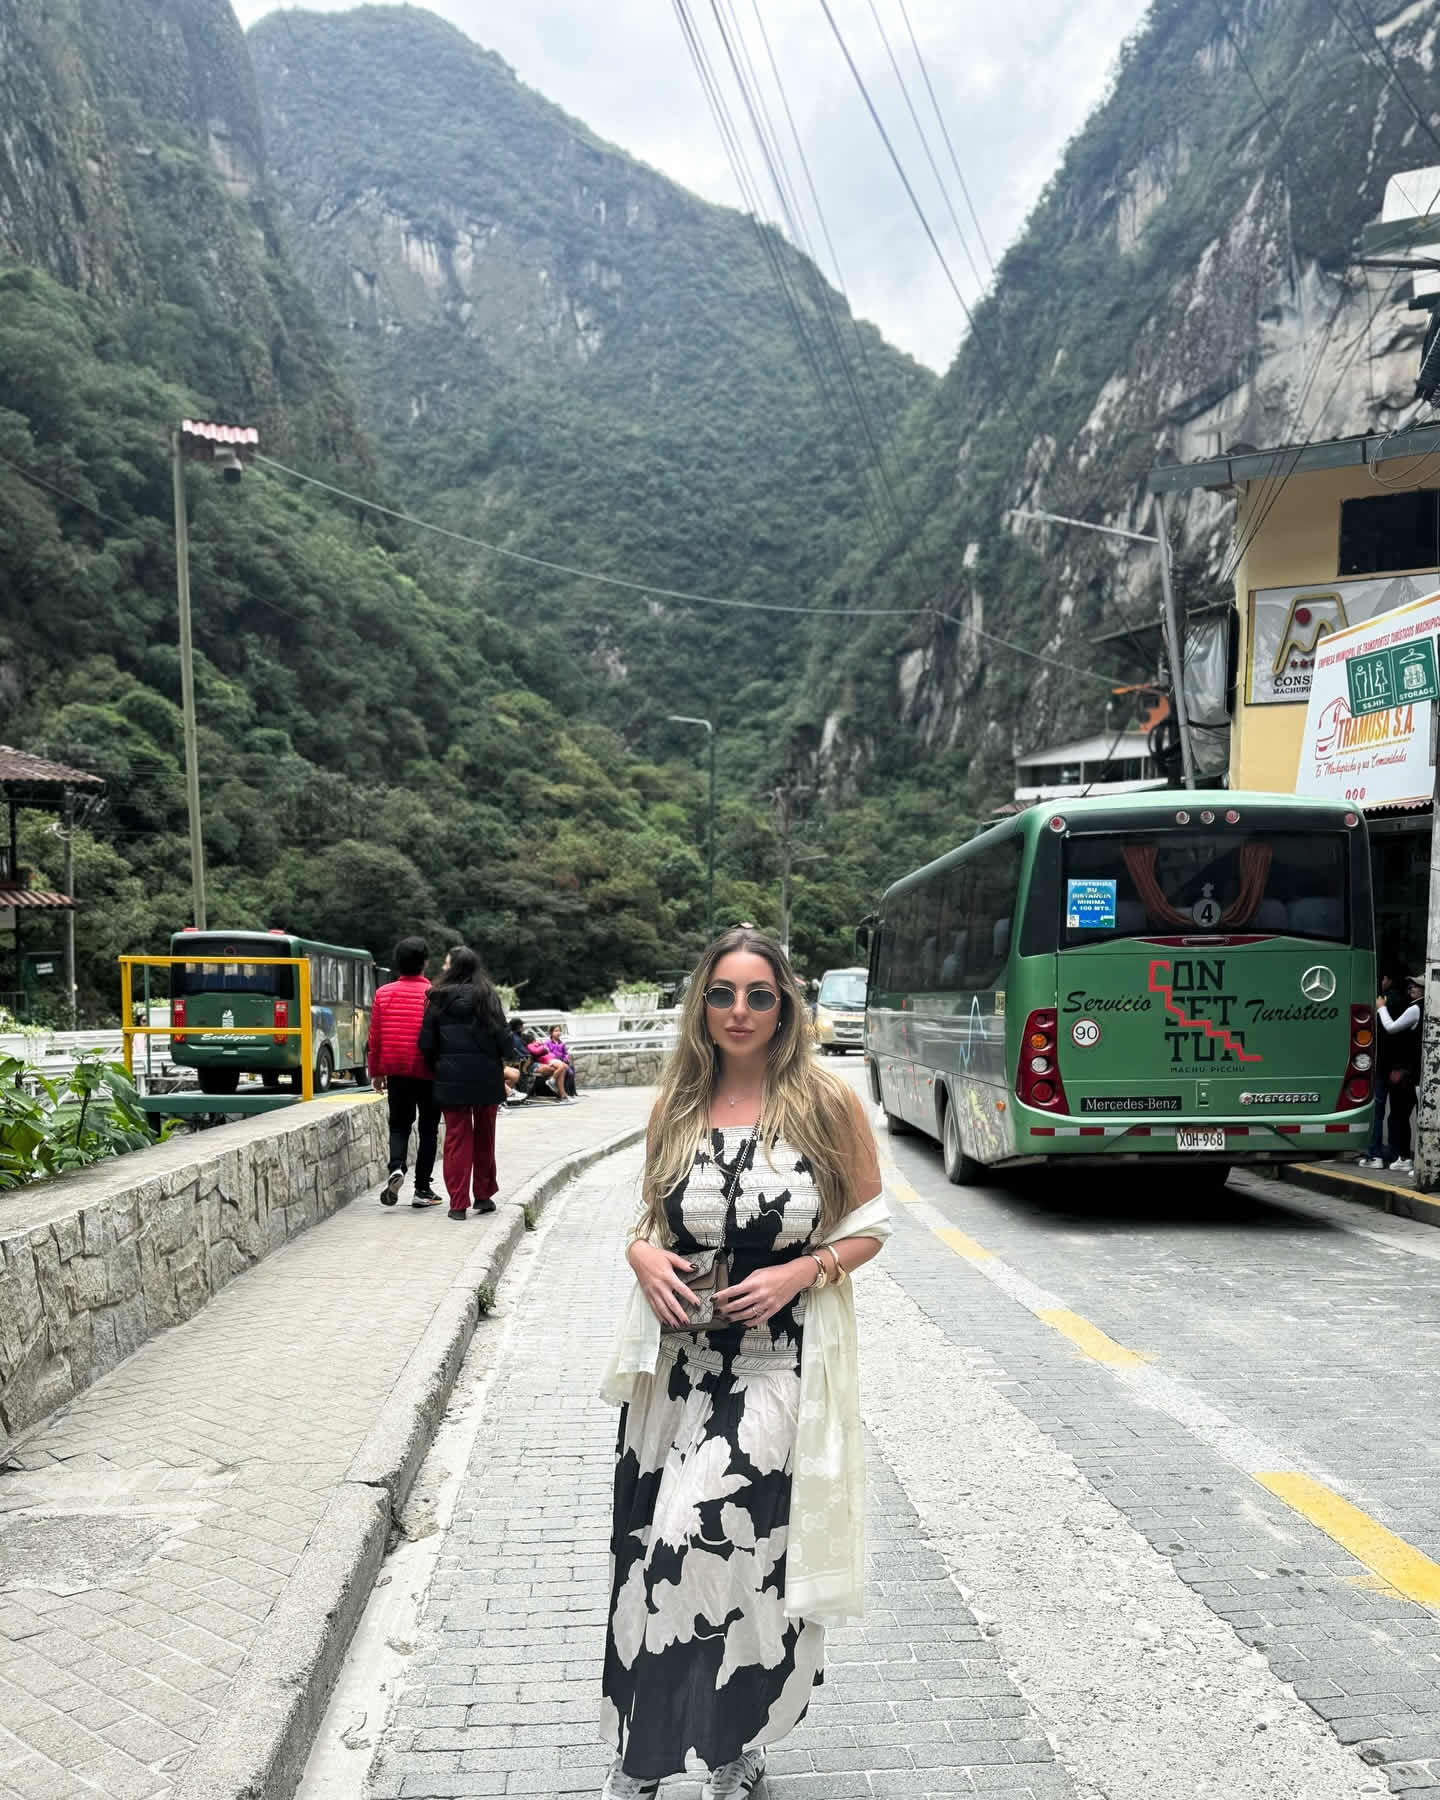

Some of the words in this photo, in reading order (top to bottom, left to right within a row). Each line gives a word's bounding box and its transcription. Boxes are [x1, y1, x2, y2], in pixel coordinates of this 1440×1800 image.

[1274, 674, 1313, 687] CONS
[1399, 686, 1435, 701] STORAGE
[1337, 708, 1391, 750] TRAMUSA
[1393, 702, 1416, 736] S.A.
[1201, 903, 1213, 923] 4
[1148, 960, 1226, 992] CON
[1062, 991, 1152, 1013] Servicio
[1075, 1025, 1098, 1041] 90
[1210, 1065, 1245, 1073] PICCHU
[1086, 1097, 1177, 1110] Mercedes-Benz
[1254, 1093, 1320, 1103] Marcopolo
